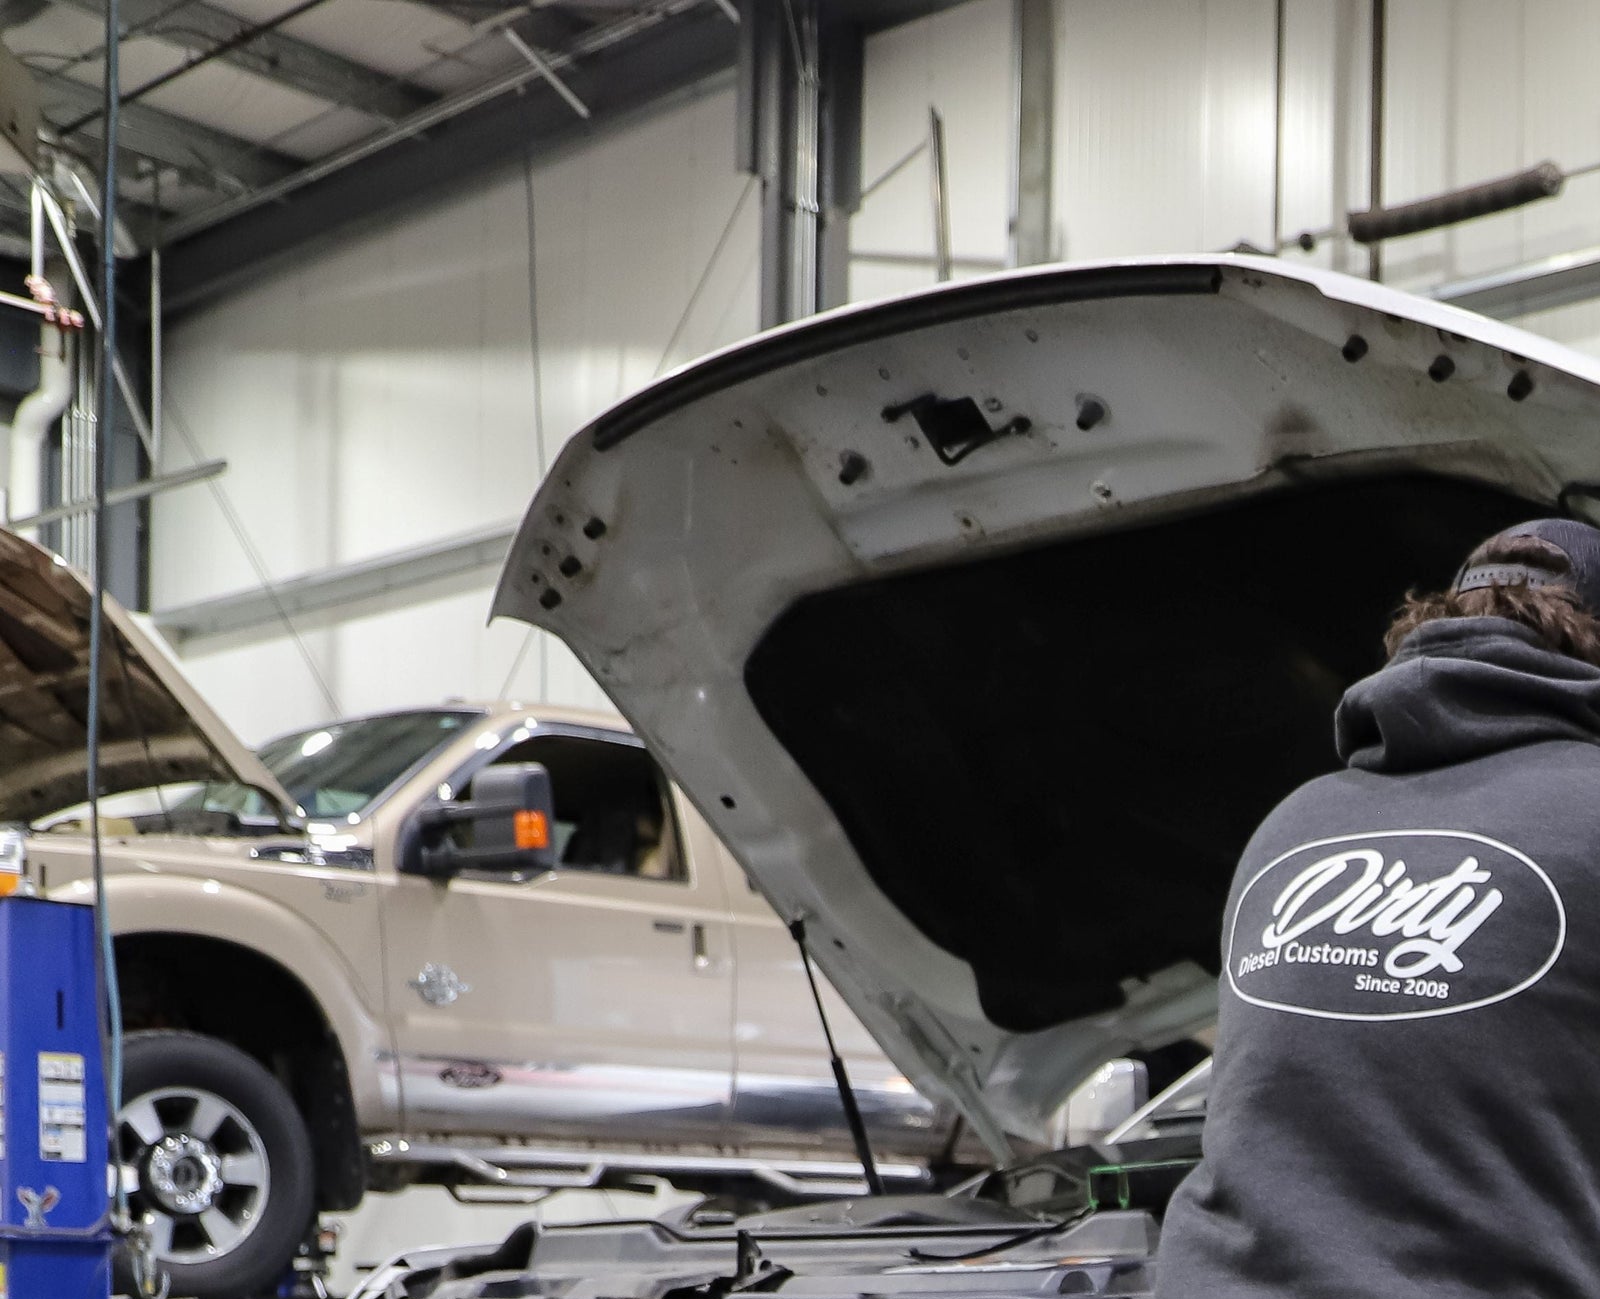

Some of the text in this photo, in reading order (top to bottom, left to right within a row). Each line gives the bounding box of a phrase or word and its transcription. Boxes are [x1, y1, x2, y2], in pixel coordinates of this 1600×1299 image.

[1262, 849, 1503, 978] Dirty
[1238, 942, 1380, 978] Diesel Customs
[1355, 973, 1450, 999] Since 2008
